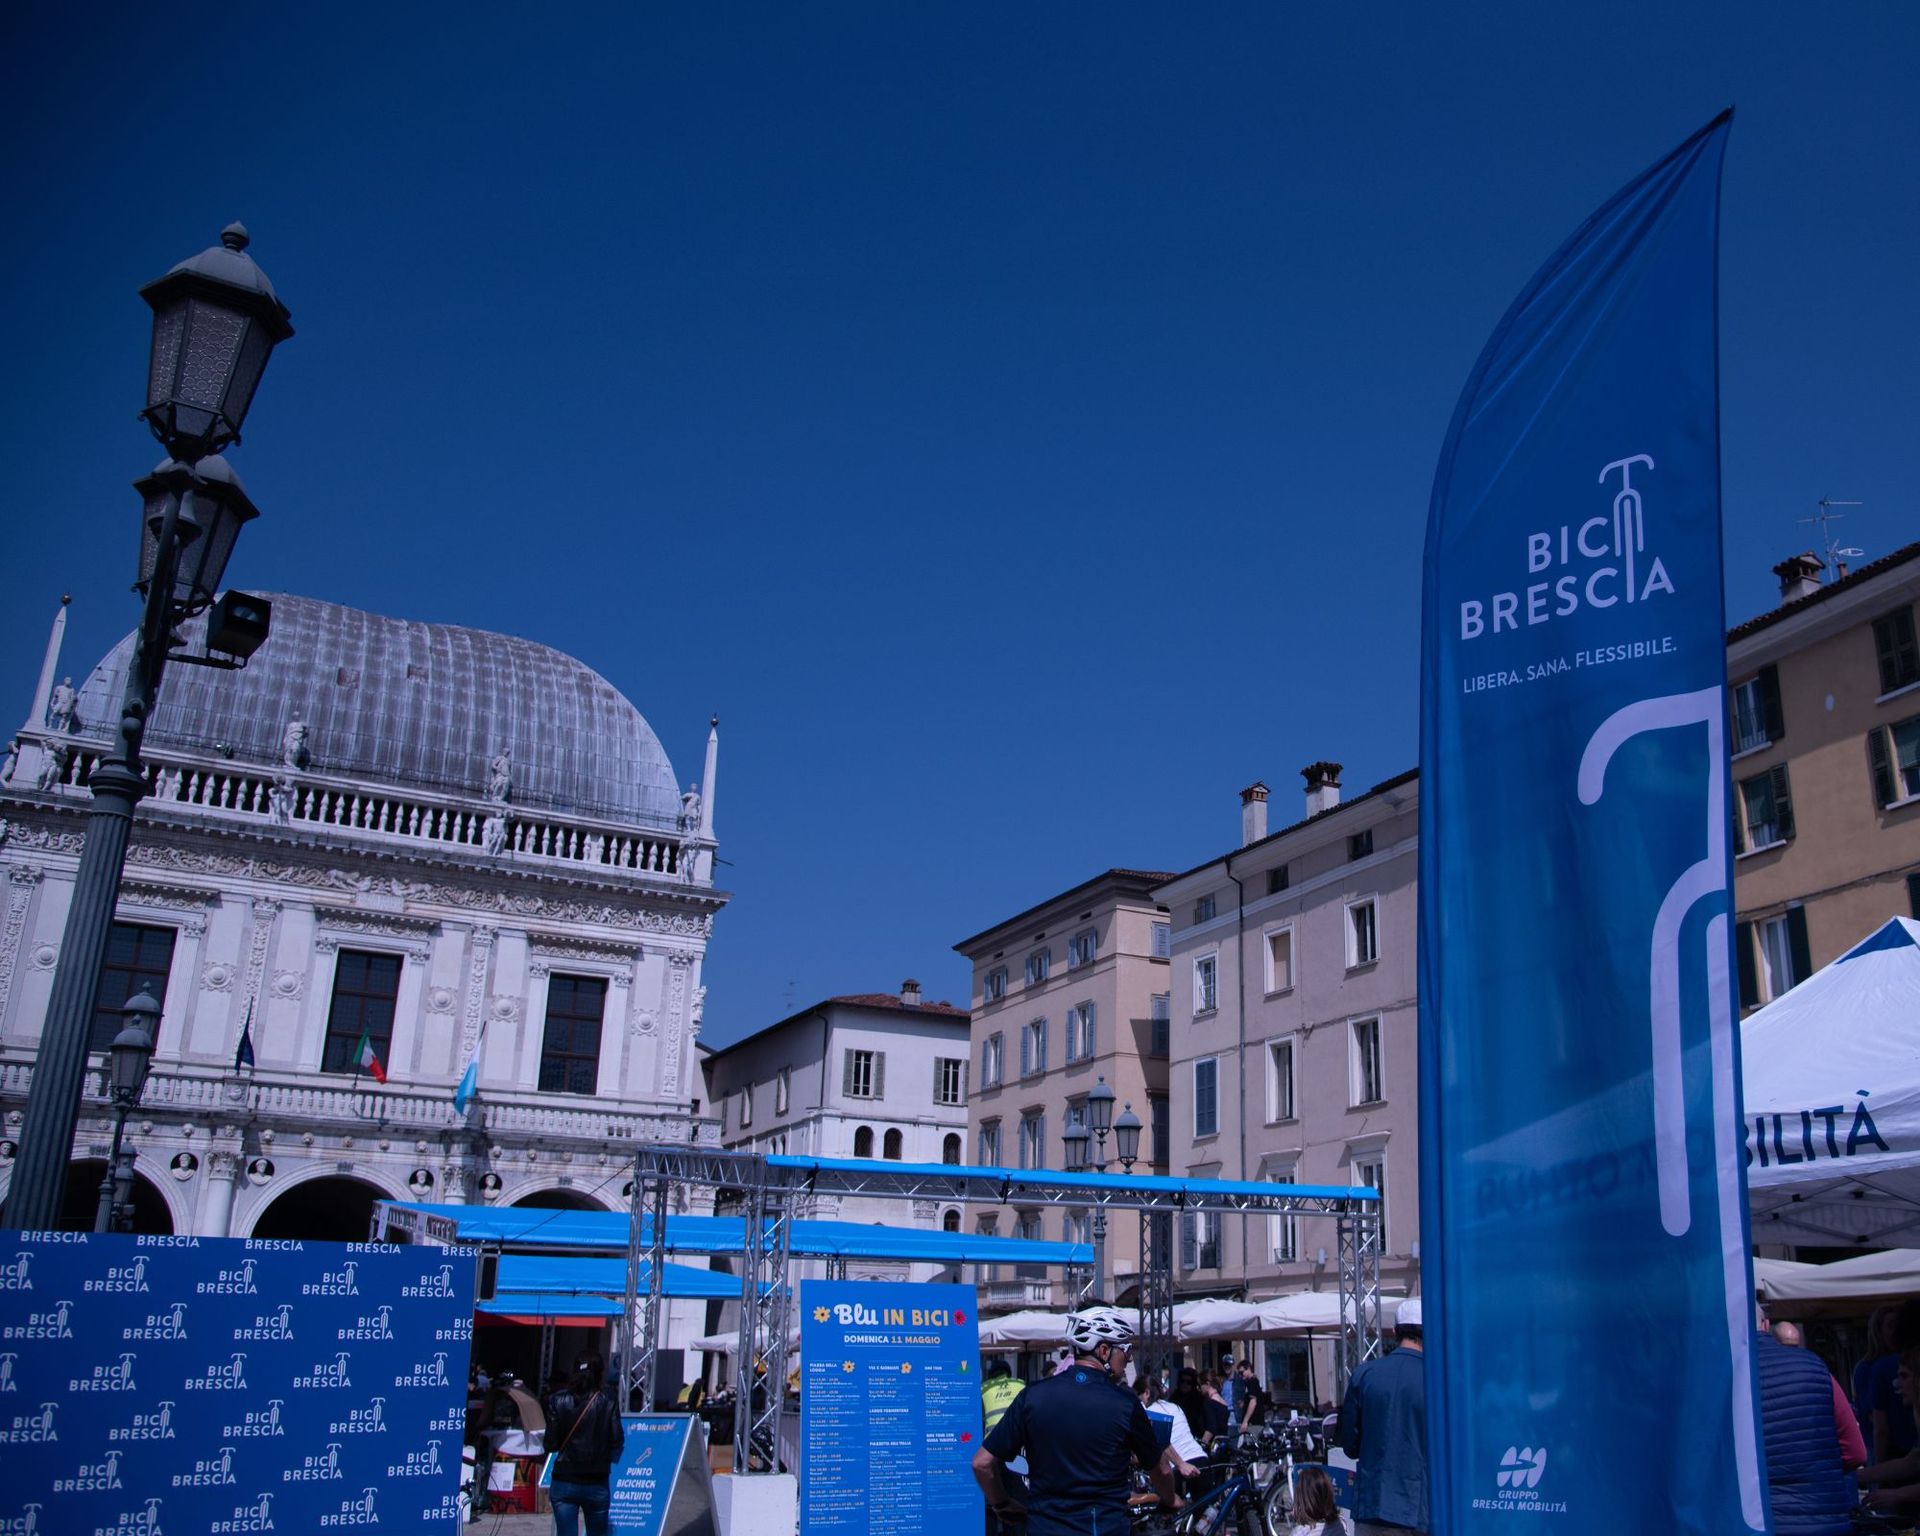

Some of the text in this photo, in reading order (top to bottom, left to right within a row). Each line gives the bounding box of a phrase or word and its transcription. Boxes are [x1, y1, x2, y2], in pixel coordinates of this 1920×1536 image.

[1460, 554, 1675, 640] BRESCIA
[1463, 637, 1677, 694] LIBERA. SANA. FLESSIBILE.
[1744, 1089, 1890, 1169] ILITÀ
[20, 1231, 88, 1243] BRESCIA
[137, 1235, 200, 1247] BRESCIA
[245, 1239, 304, 1251] BRESCIA
[346, 1243, 401, 1254] BRESCIA
[84, 1280, 149, 1292] BRESCIA
[197, 1283, 257, 1294] BRESCIA
[302, 1284, 359, 1296] BRESCIA
[402, 1287, 455, 1298] BRESCIA
[834, 1303, 949, 1327] Blu IN BICI
[3, 1327, 73, 1339] BRESCIA
[123, 1328, 187, 1340] BRESCIA
[234, 1329, 294, 1340] BRESCIA
[338, 1329, 394, 1341] BRESCIA
[844, 1335, 941, 1345] DOMENICA 11 MAGGIO
[69, 1378, 136, 1391] BRESCIA
[185, 1378, 247, 1390] BRESCIA
[293, 1377, 351, 1388] BRESCIA
[395, 1375, 449, 1387] BRESCIA
[109, 1427, 175, 1440] BRESCIA
[223, 1425, 284, 1437] BRESCIA
[330, 1421, 387, 1434] BRESCIA
[283, 1469, 343, 1481] BRESCIA
[388, 1464, 443, 1477] BRESCIA
[626, 1467, 653, 1476] PUNTO
[53, 1478, 123, 1492] BRESCIA
[172, 1474, 236, 1487] BRESCIA
[613, 1491, 652, 1501] GRATUITO
[1498, 1490, 1539, 1500] GRUPPO
[1472, 1499, 1514, 1510] BRESCIA
[320, 1513, 379, 1526] BRESCIA
[211, 1519, 275, 1533] BRESCIA
